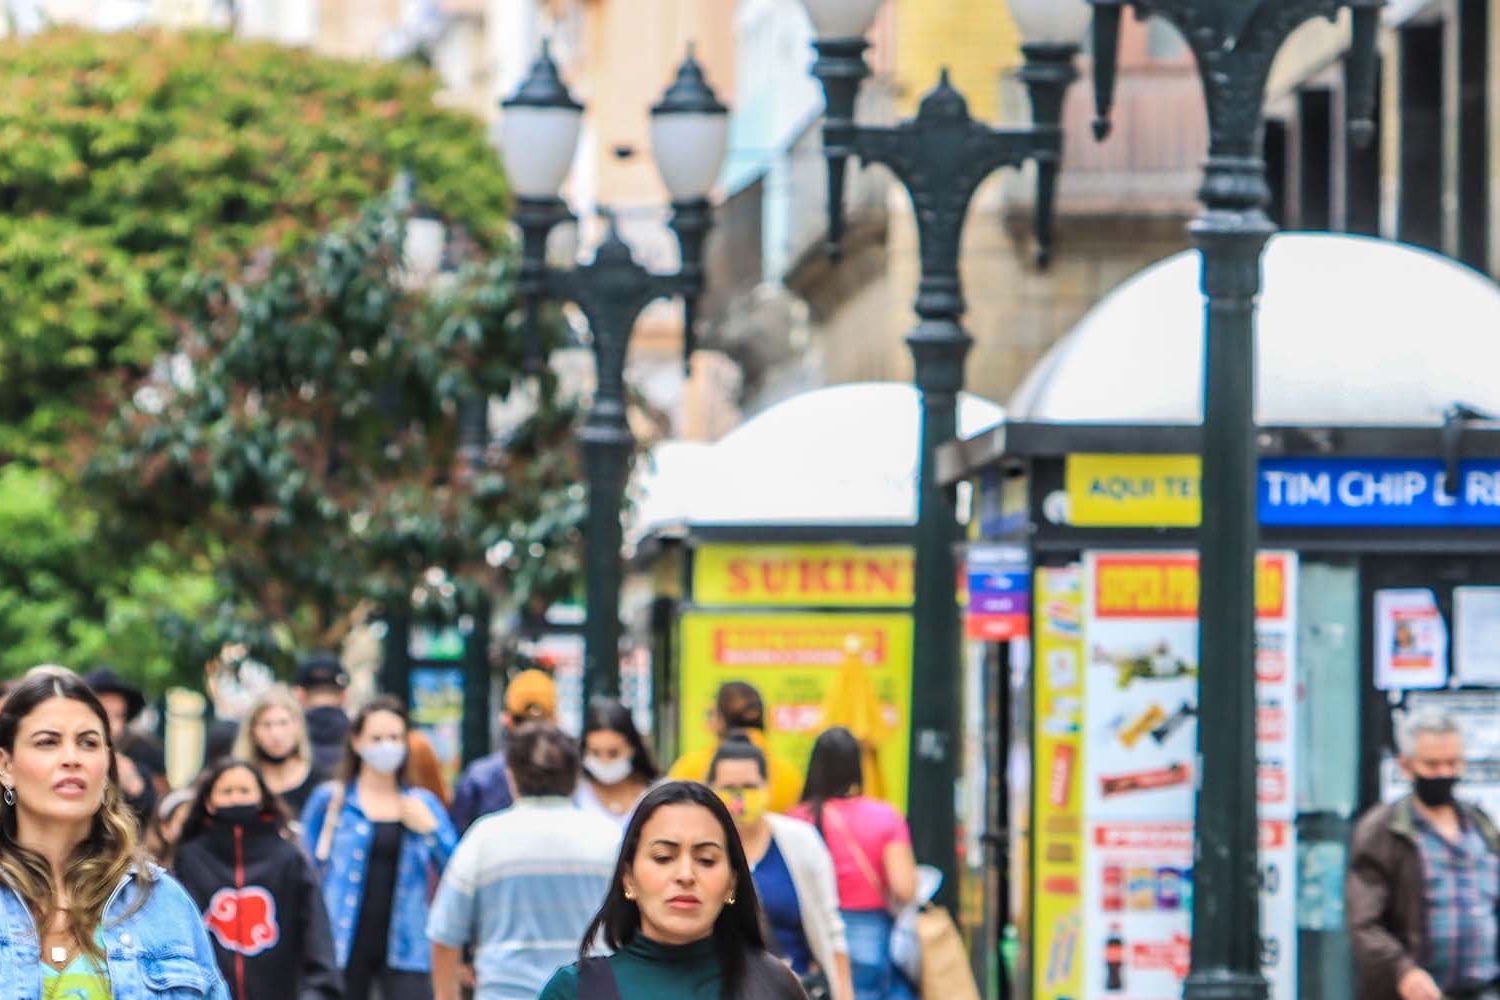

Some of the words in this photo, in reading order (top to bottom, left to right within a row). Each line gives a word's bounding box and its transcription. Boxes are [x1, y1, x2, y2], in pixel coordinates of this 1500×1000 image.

[1089, 475, 1156, 500] AQUI
[1264, 470, 1331, 507] TIM
[1337, 470, 1427, 508] CHIP
